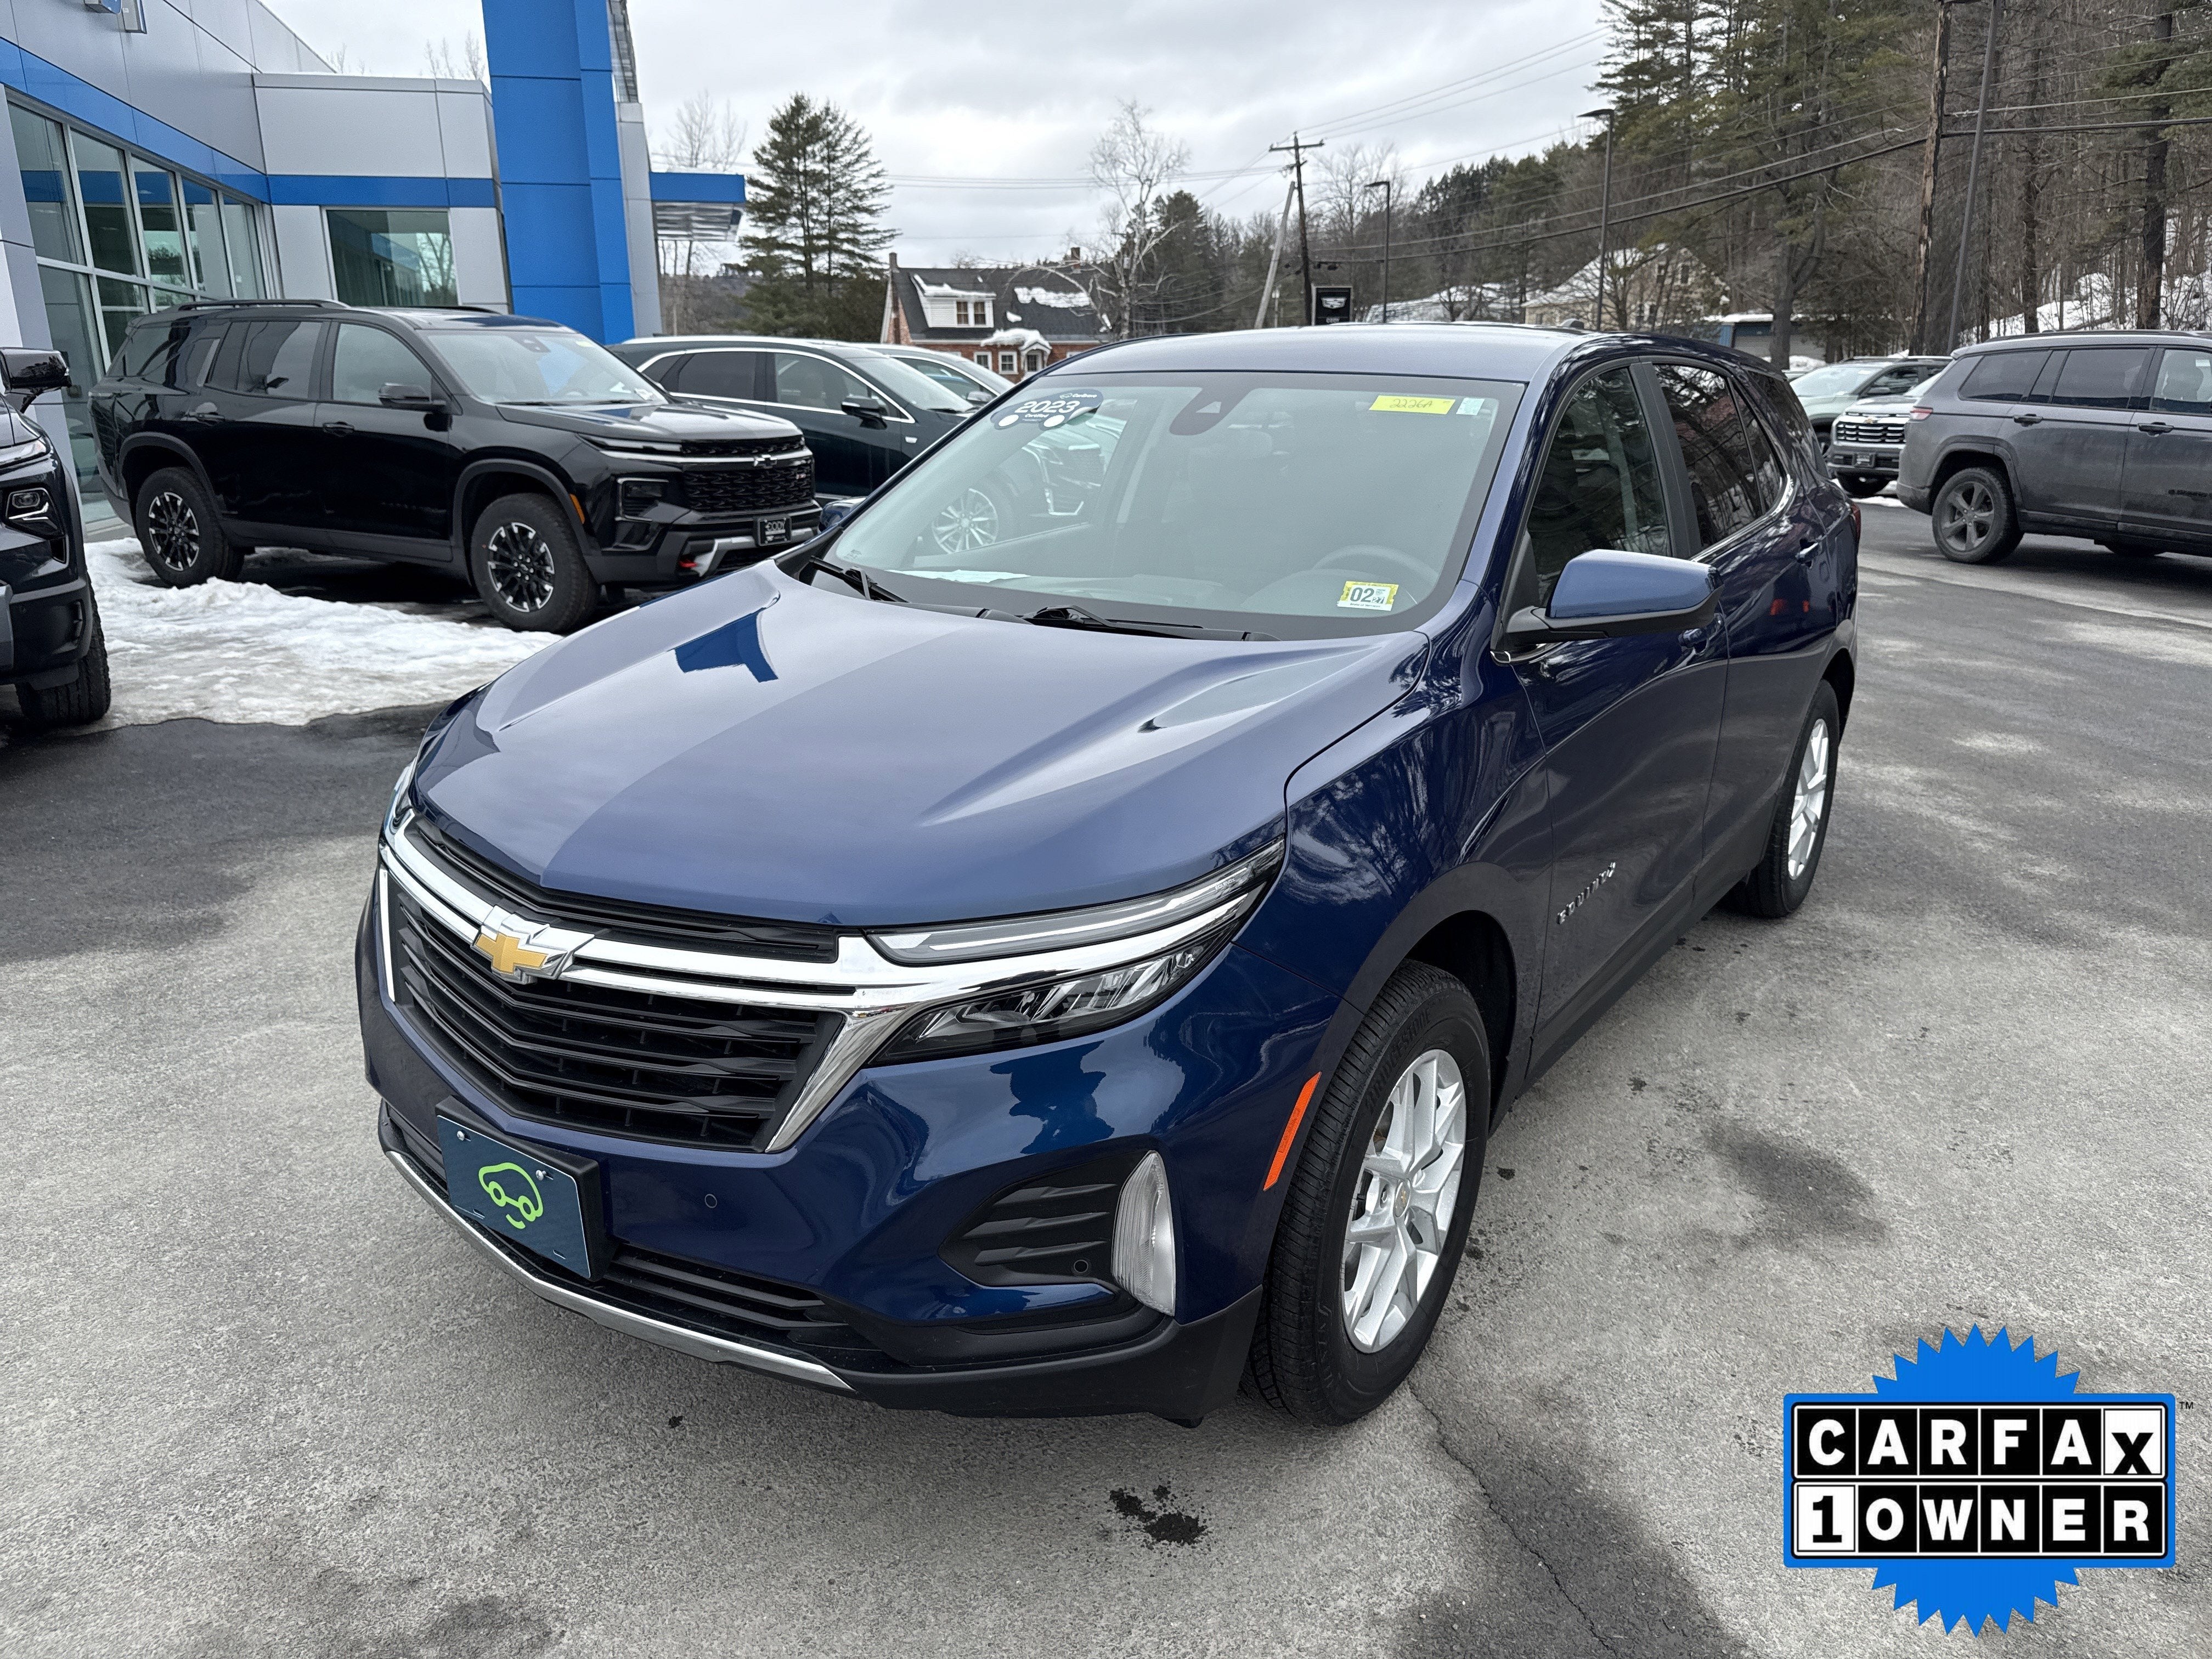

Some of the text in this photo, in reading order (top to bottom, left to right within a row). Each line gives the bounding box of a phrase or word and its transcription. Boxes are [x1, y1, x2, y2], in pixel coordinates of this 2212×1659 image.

[1014, 400, 1080, 414] 2023
[1389, 398, 1433, 409] 2226A
[1350, 587, 1374, 602] 02
[1556, 862, 1617, 926] EQUINOX
